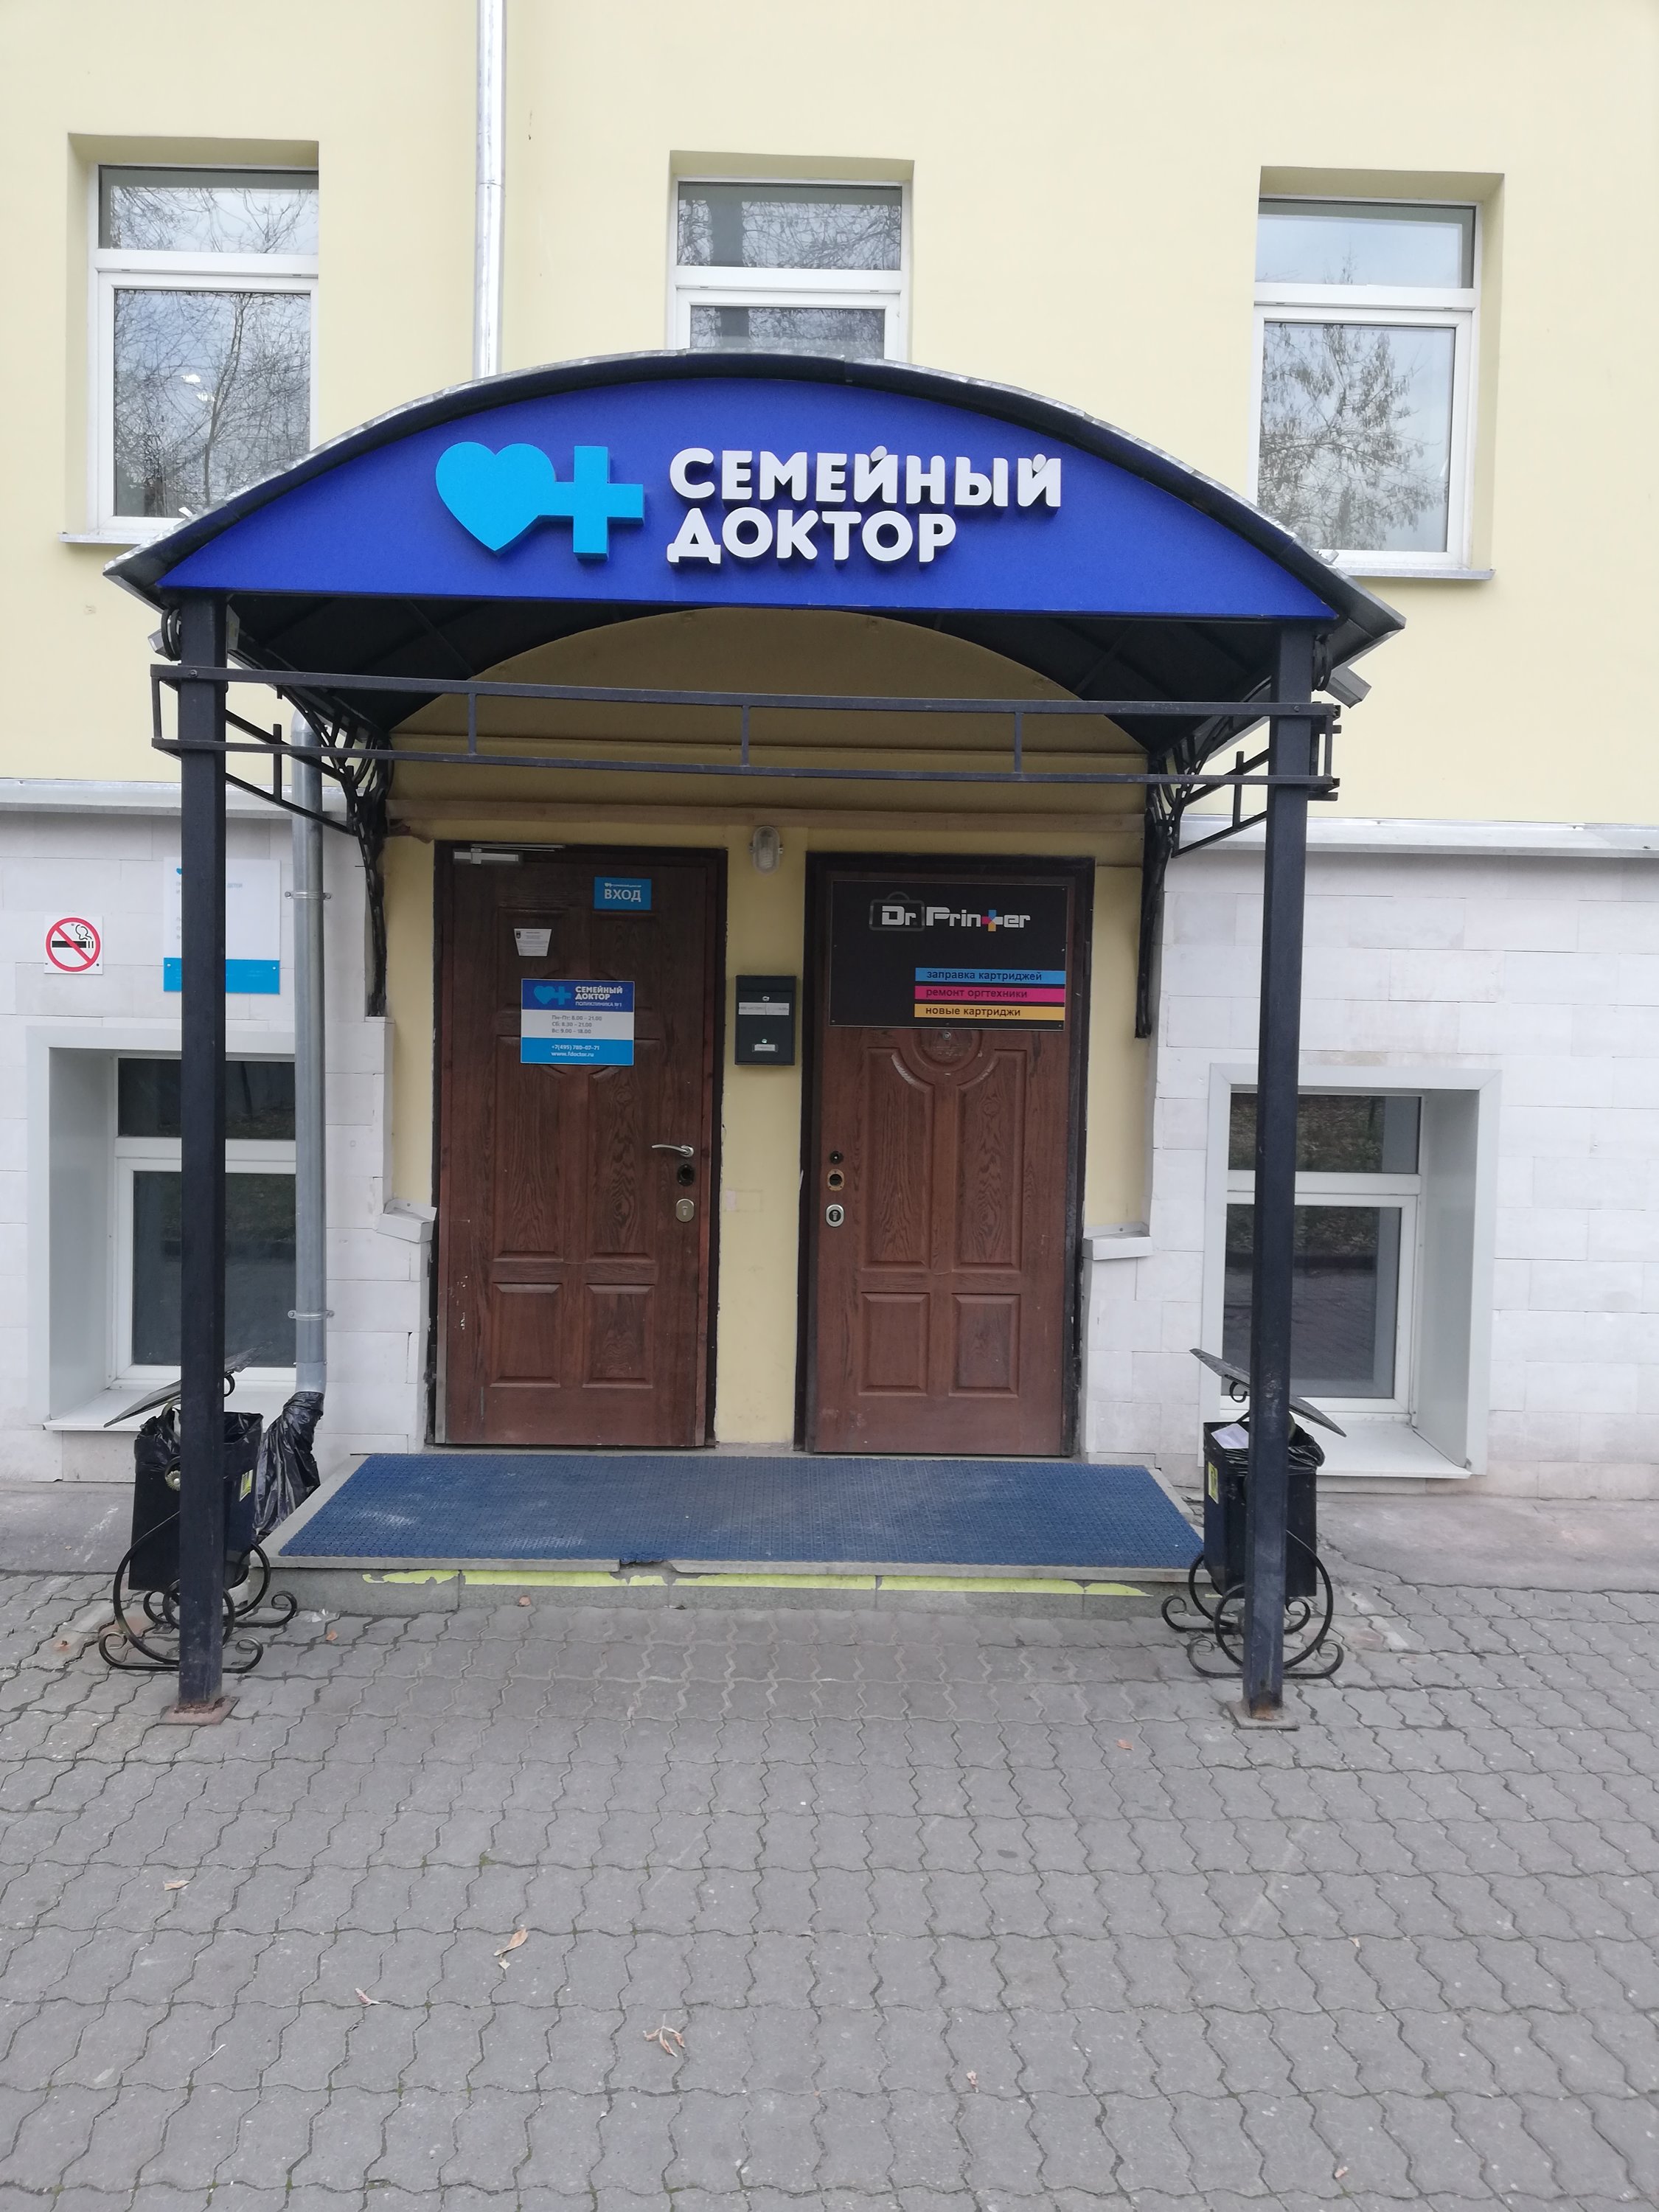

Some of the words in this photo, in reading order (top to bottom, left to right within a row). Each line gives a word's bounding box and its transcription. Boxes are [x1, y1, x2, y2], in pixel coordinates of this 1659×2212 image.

[669, 445, 1061, 507] СЕМЕЙНЫЙ
[667, 507, 956, 564] ДОКТОР
[604, 888, 641, 902] ВХОД
[927, 970, 975, 980] заправка
[978, 972, 1042, 981] картриджей
[575, 985, 623, 994] СЕМЕЙНЫЙ
[926, 989, 964, 998] ремонт
[967, 991, 1027, 999] оргтехники
[963, 1009, 1020, 1017] картриджи
